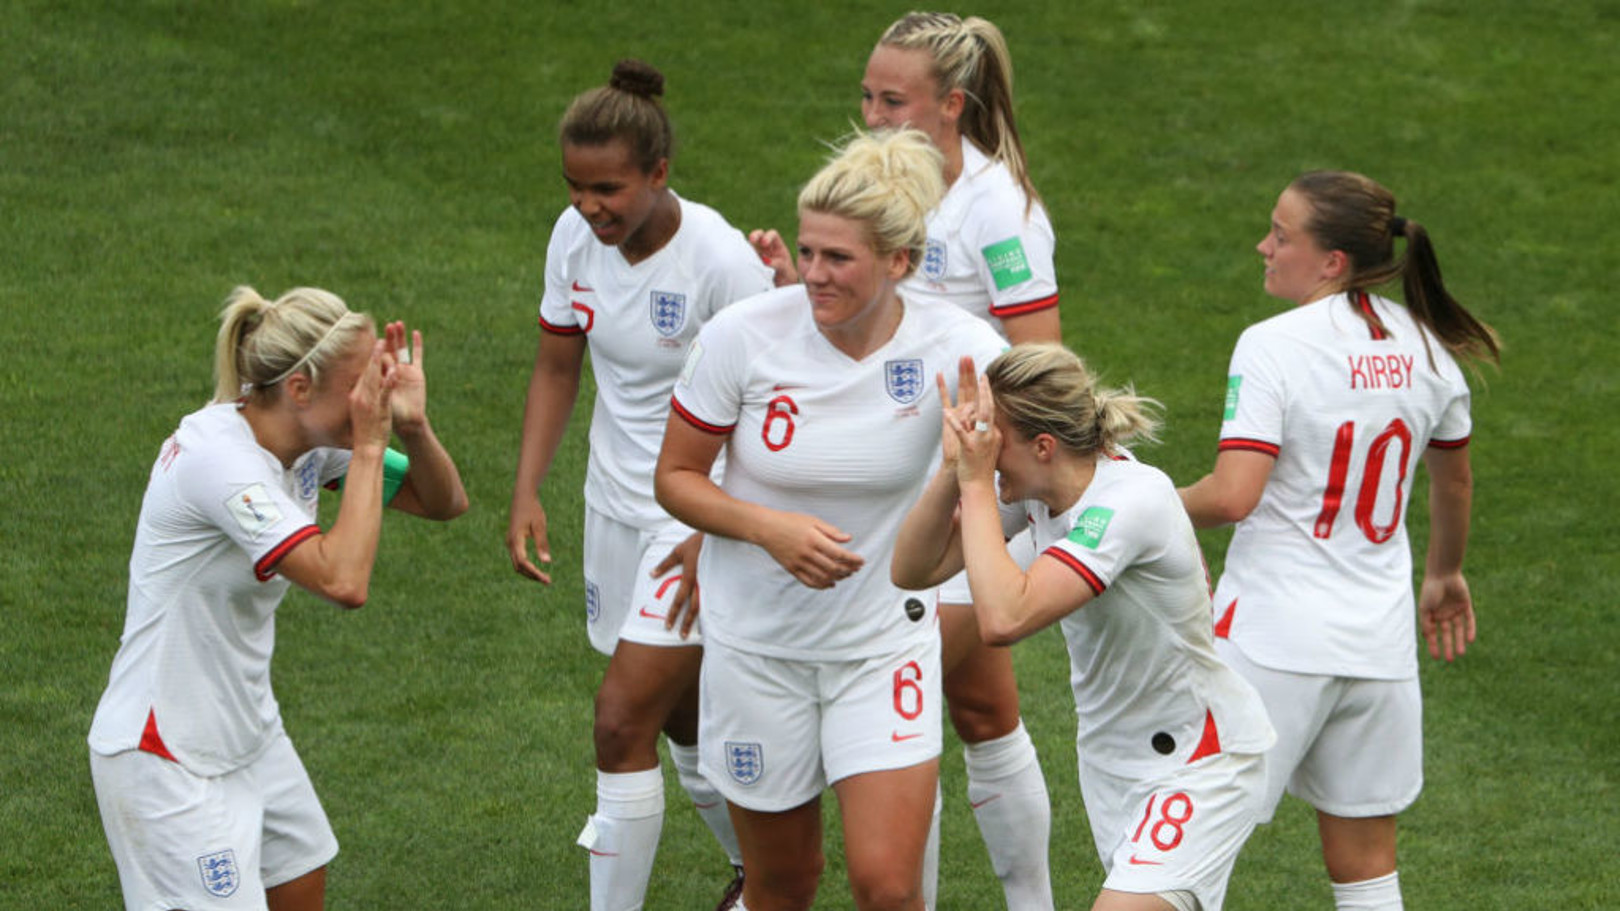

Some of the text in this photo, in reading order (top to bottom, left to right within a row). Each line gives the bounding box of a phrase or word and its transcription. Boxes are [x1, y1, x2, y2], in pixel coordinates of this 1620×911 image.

[1348, 355, 1413, 389] KIRBY
[761, 395, 798, 452] 6
[1313, 418, 1412, 544] 10
[893, 660, 923, 721] 6
[1131, 792, 1193, 852] 18
